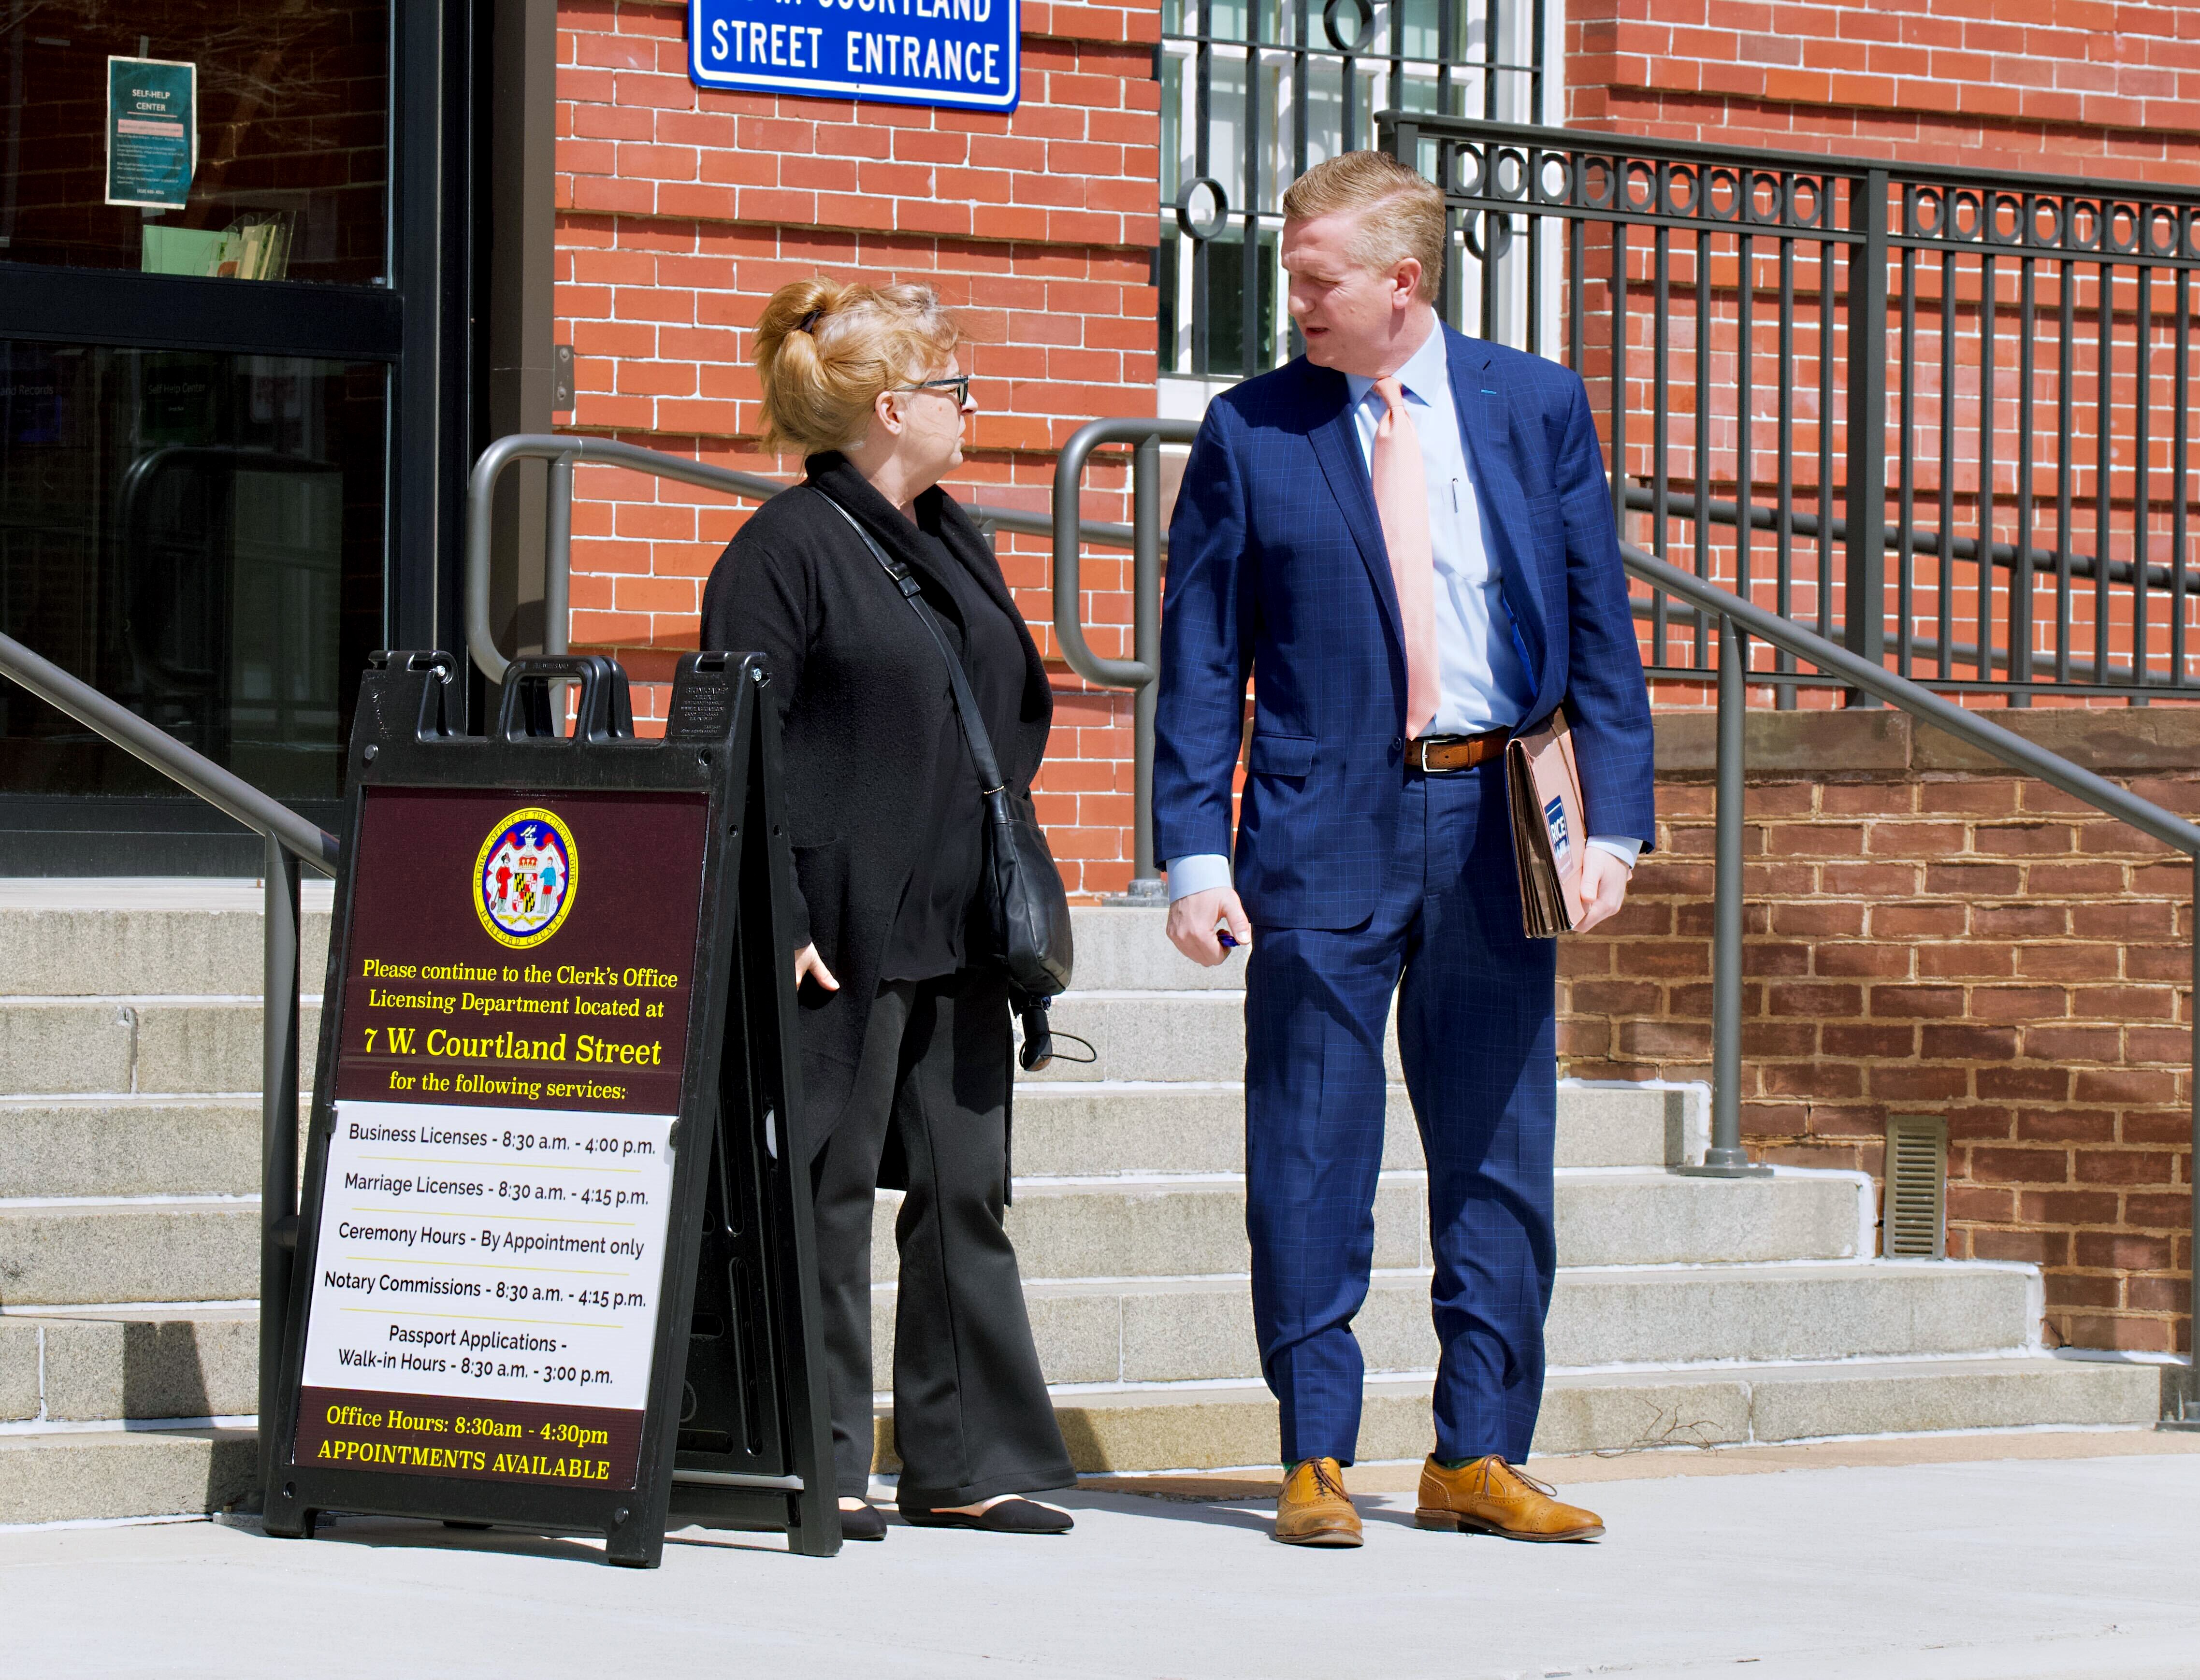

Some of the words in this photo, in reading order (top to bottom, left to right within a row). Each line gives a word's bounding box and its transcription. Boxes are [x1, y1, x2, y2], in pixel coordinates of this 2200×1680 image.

[711, 19, 823, 68] STREET
[847, 30, 1000, 85] ENTRANCE
[132, 89, 170, 99] SELF-HELP
[136, 102, 166, 112] CENTER
[19, 384, 54, 396] Records
[147, 383, 163, 395] Self
[164, 383, 180, 396] Help
[182, 382, 205, 393] Center
[1550, 815, 1566, 844] RICE
[476, 845, 491, 888] CLERK'S
[491, 816, 516, 843] OFFICE
[519, 812, 530, 820] OF
[532, 812, 548, 820] THE
[549, 818, 572, 849] CIRCUIT
[480, 909, 521, 945] HARFORD
[526, 913, 564, 945] COUNTY
[363, 959, 417, 978] Please
[421, 962, 497, 981] continue
[502, 966, 519, 982] to
[524, 966, 552, 983] the
[557, 965, 618, 986] Clerk's
[623, 968, 678, 988] Office
[369, 989, 456, 1014] Licensing
[461, 992, 569, 1016] Department
[575, 996, 640, 1017] located
[646, 1002, 664, 1018] at
[364, 1028, 378, 1053] 7
[387, 1027, 416, 1054] W.
[427, 1029, 566, 1061] Courtland
[576, 1034, 662, 1065] Street
[389, 1071, 416, 1090] for
[422, 1073, 450, 1091] the
[455, 1074, 542, 1100] following
[546, 1083, 626, 1099] services:
[349, 1123, 416, 1142] Business
[420, 1126, 487, 1146] Licenses
[502, 1131, 535, 1151] 8:30
[539, 1136, 569, 1150] a.m.
[585, 1138, 618, 1154] 4:00
[622, 1140, 655, 1158] p.m.
[345, 1172, 412, 1196] Marriage
[417, 1176, 483, 1196] Licenses
[498, 1181, 531, 1201] 8:30
[535, 1187, 565, 1200] a.m.
[581, 1189, 611, 1206] 4:15
[616, 1191, 648, 1208] p.m.
[339, 1222, 417, 1247] Ceremony
[420, 1226, 466, 1245] Hours
[481, 1230, 501, 1252] By
[503, 1232, 606, 1253] Appointment
[610, 1238, 644, 1261] only
[324, 1271, 376, 1294] Notary
[379, 1274, 481, 1296] Commissions
[496, 1281, 528, 1302] 8:30
[532, 1288, 563, 1302] a.m.
[578, 1290, 609, 1307] 4:15
[613, 1292, 646, 1310] p.m.
[389, 1325, 456, 1348] Passport
[459, 1330, 556, 1352] Applications
[339, 1349, 396, 1369] Walk-in
[401, 1353, 446, 1372] Hours
[461, 1357, 493, 1378] 8:30
[497, 1364, 528, 1378] a.m.
[543, 1365, 576, 1383] 3:00
[580, 1369, 612, 1387] p.m.
[327, 1406, 382, 1427] Office
[387, 1410, 449, 1432] Hours:
[455, 1417, 522, 1438] 8:30am
[540, 1423, 608, 1448] 4:30pm
[317, 1440, 485, 1470] APPOINTMENTS
[492, 1453, 610, 1480] AVAILABLE
